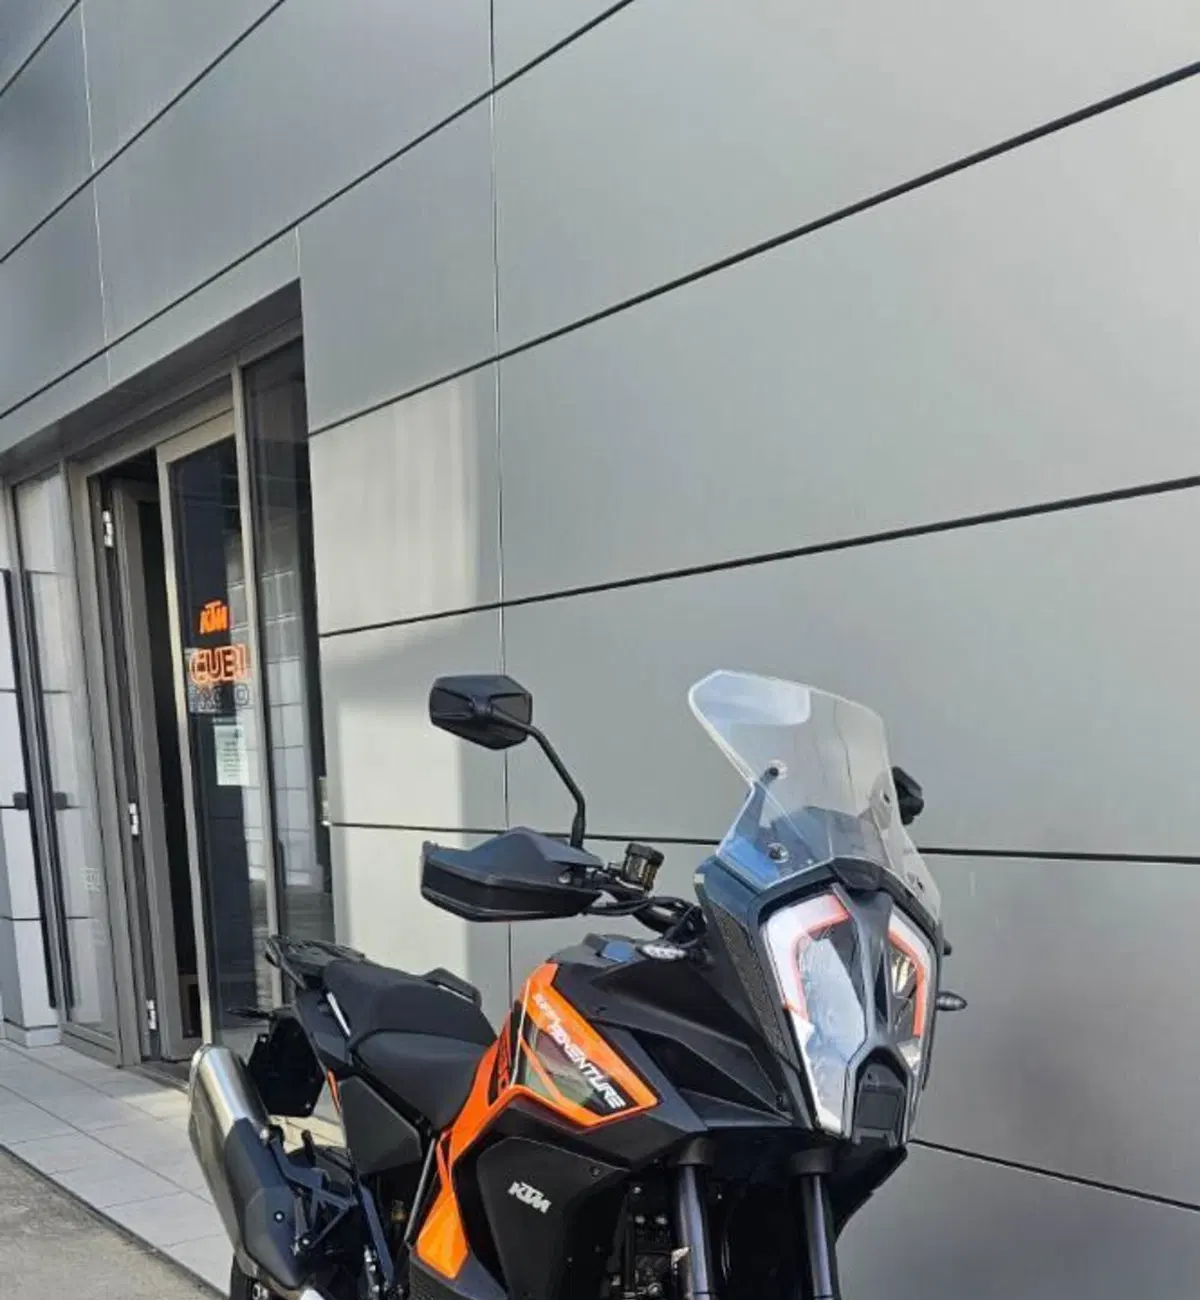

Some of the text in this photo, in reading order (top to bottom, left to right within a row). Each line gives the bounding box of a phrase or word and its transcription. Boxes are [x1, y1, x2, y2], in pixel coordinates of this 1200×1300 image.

[200, 600, 228, 634] KTM
[548, 1019, 627, 1109] ADVENTURE
[508, 1180, 552, 1214] KTM
